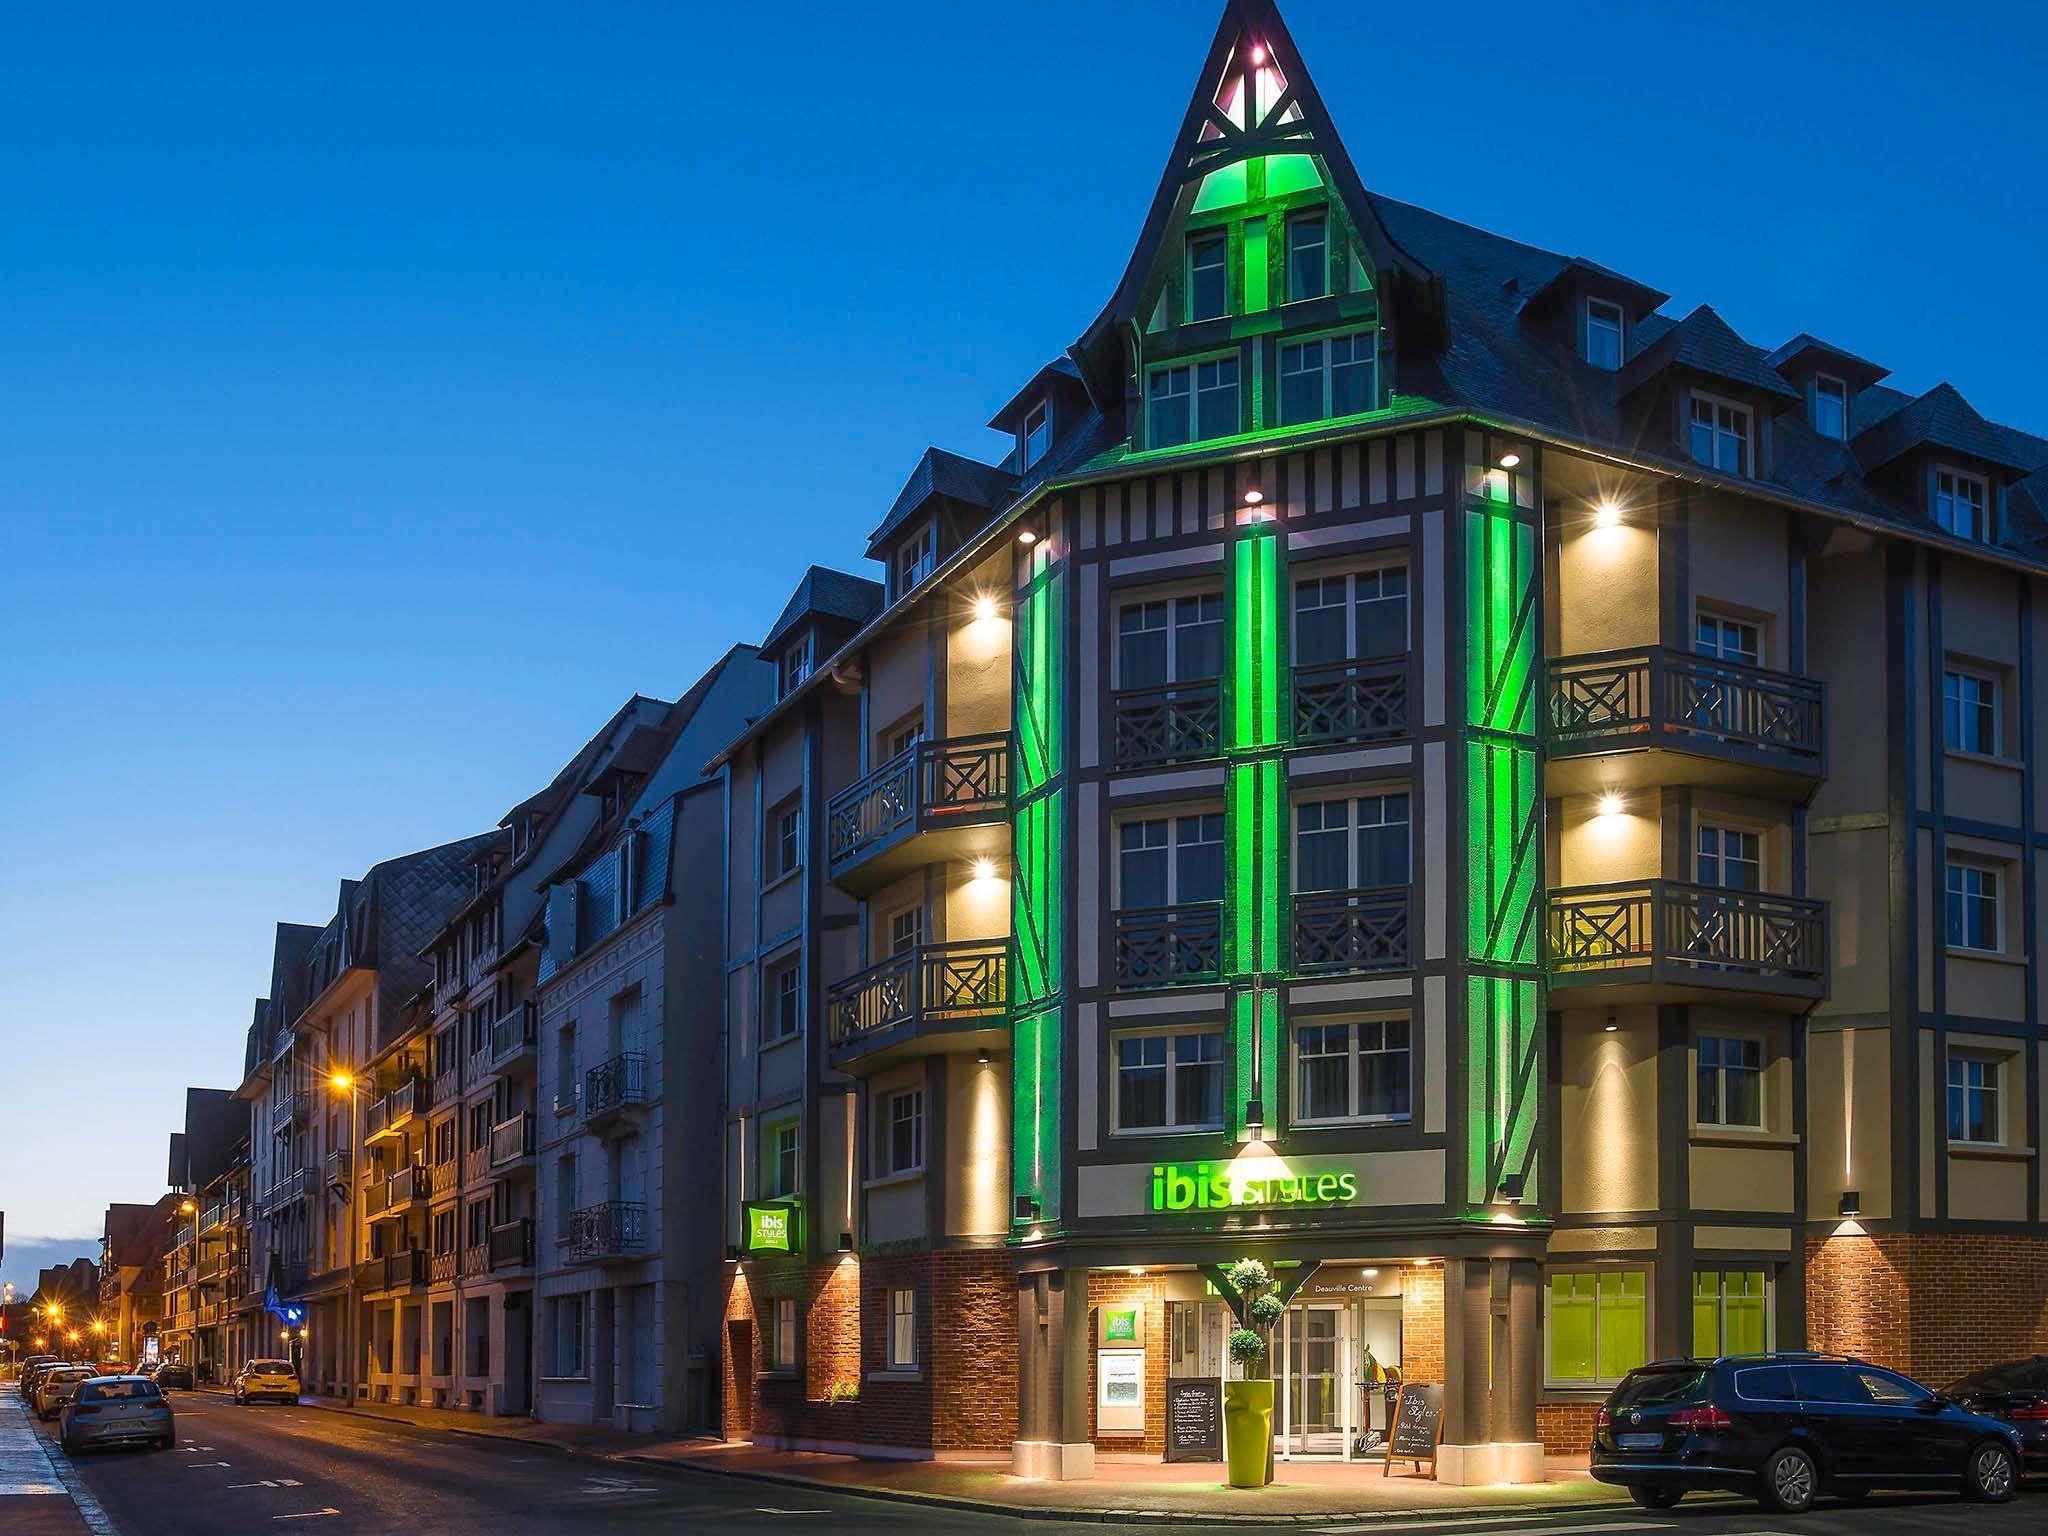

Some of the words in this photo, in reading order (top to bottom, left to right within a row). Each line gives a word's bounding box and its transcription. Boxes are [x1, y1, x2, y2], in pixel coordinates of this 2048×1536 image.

[1153, 1164, 1235, 1210] ibis
[761, 1215, 783, 1229] ibis
[1315, 1284, 1346, 1293] Deauville
[1347, 1284, 1374, 1292] Centre
